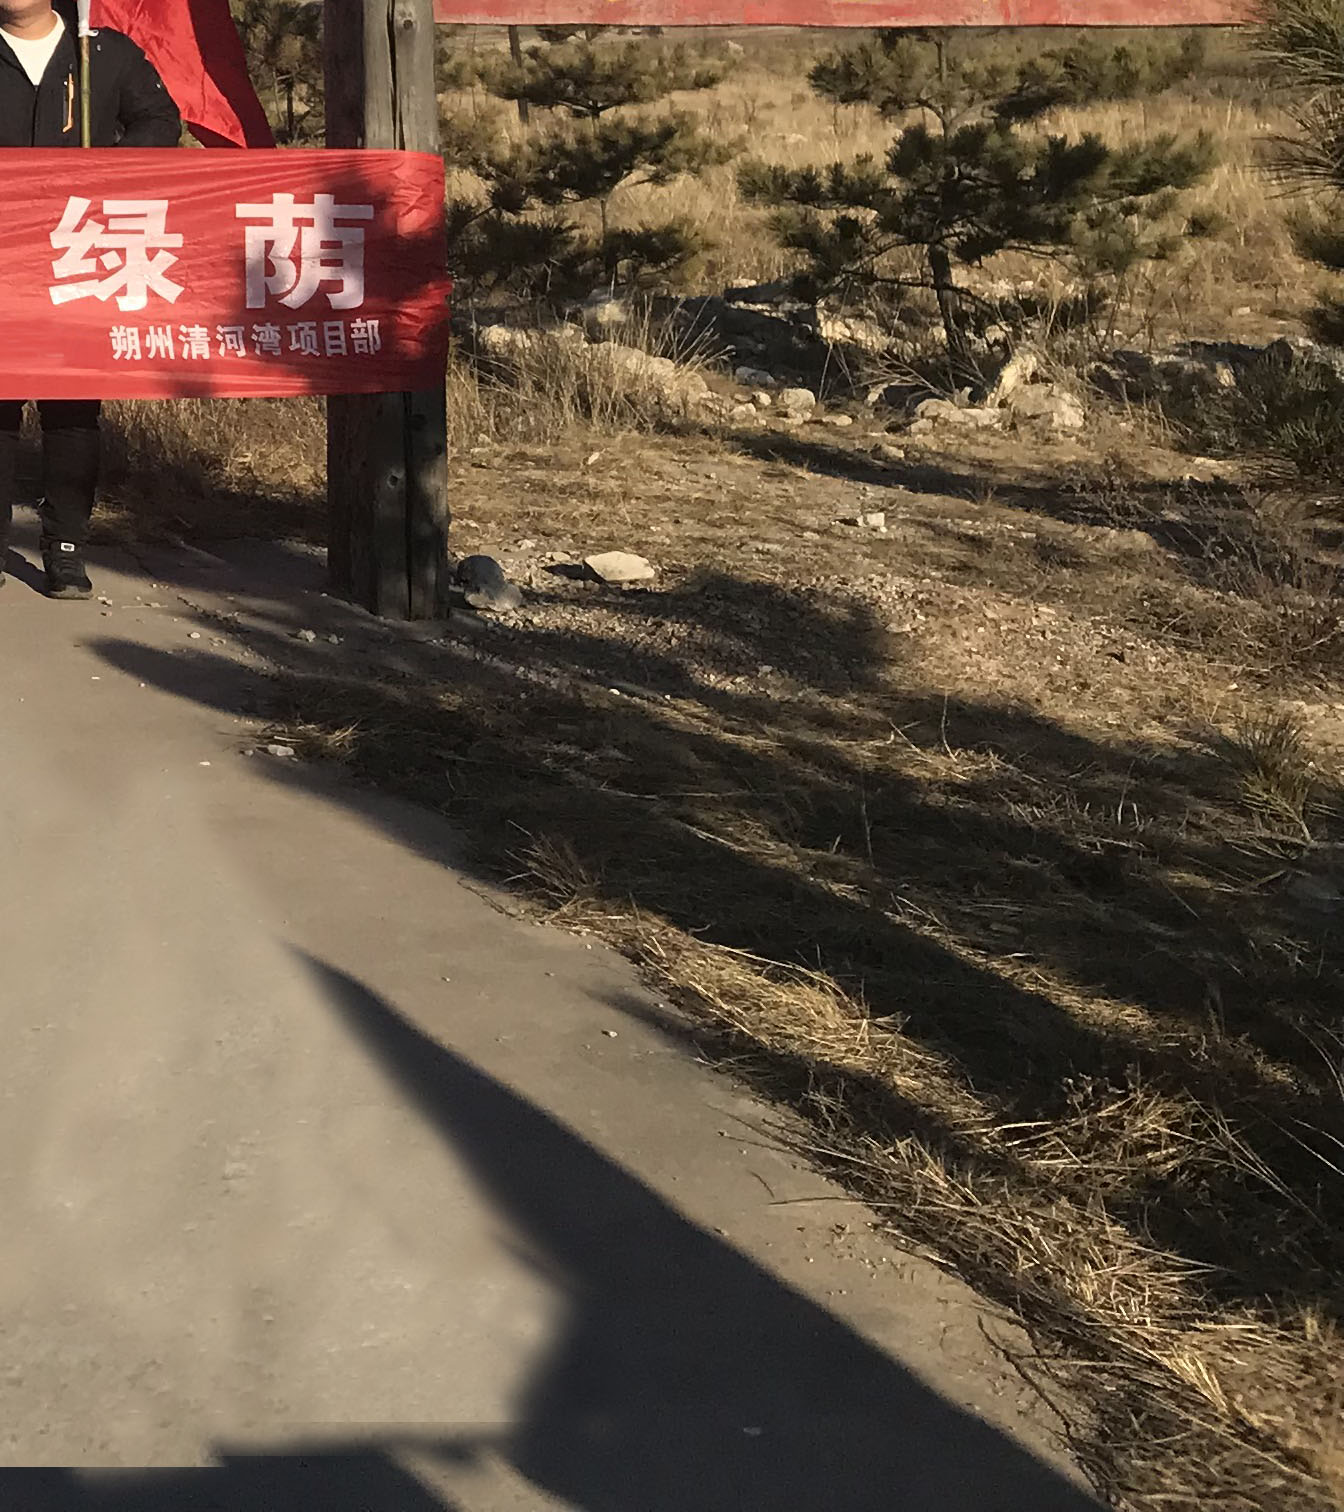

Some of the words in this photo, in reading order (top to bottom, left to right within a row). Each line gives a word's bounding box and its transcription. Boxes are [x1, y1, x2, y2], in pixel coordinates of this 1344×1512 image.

[109, 318, 383, 361] 朔州清河湾项目部
